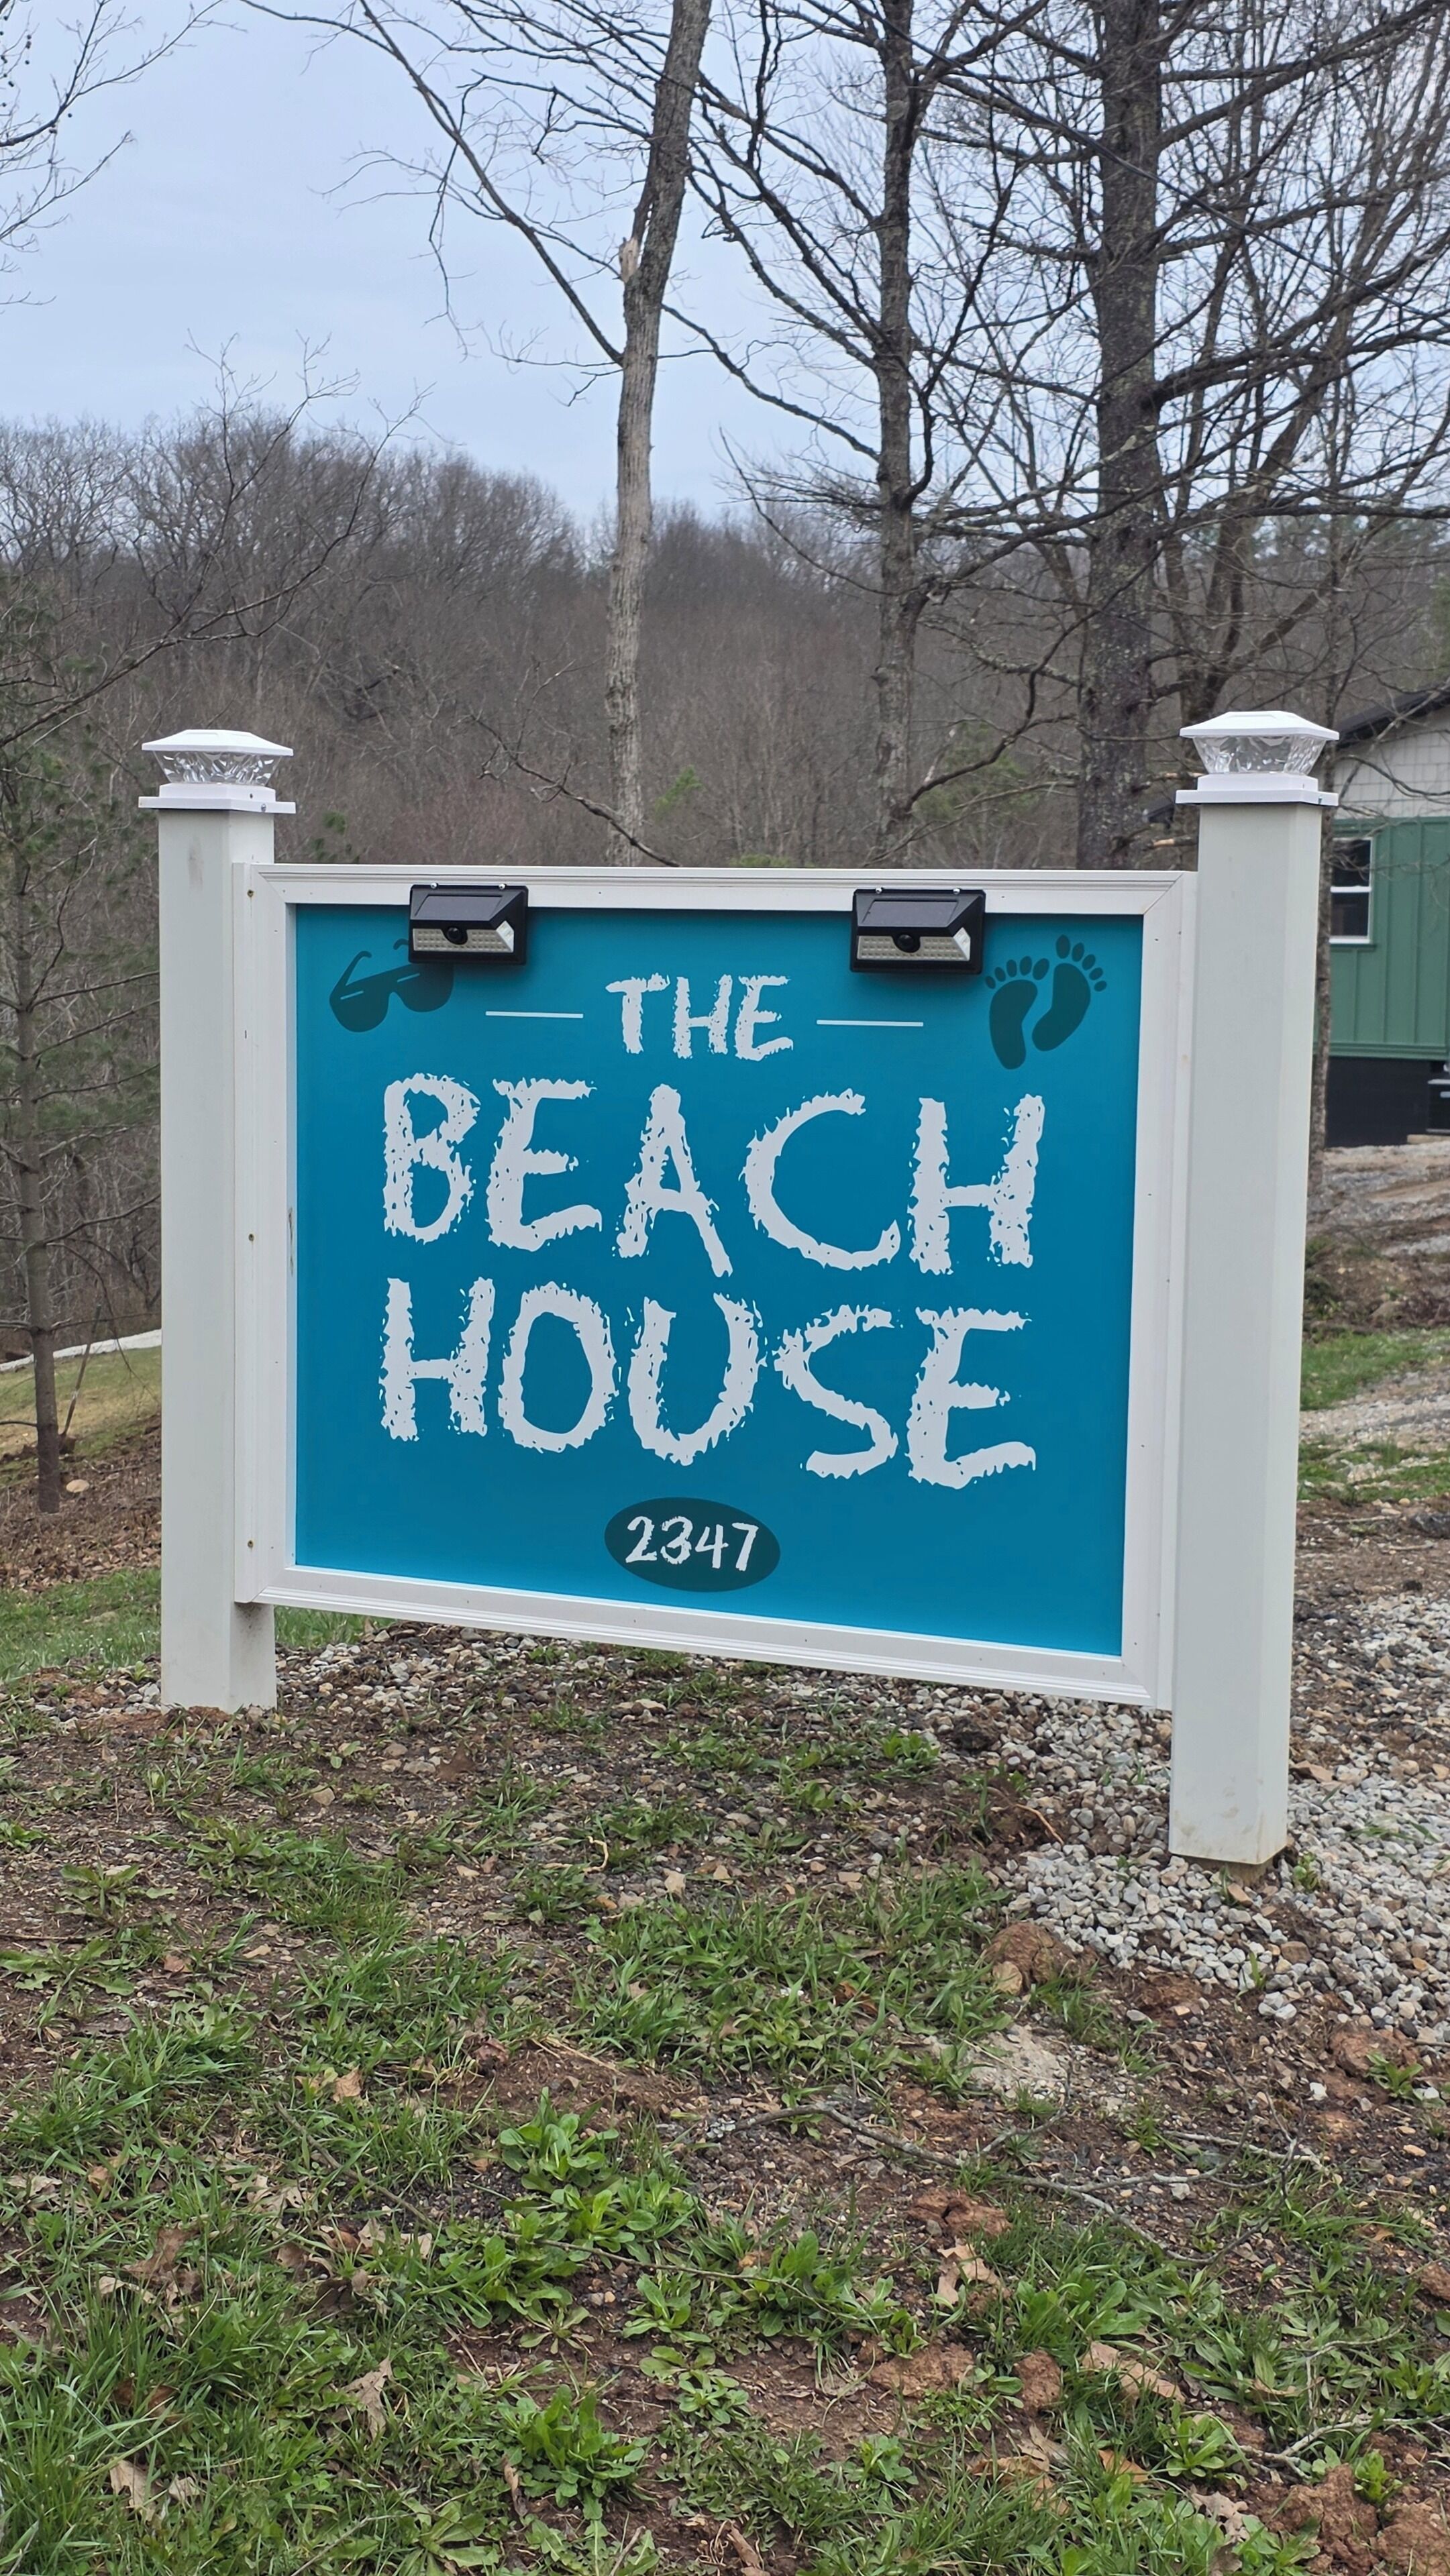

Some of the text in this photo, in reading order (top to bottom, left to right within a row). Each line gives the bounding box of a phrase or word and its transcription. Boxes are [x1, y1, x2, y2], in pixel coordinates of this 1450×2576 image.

[606, 973, 793, 1061] THE
[383, 1073, 1045, 1277] BEACH
[379, 1277, 1035, 1489] HOUSE
[626, 1516, 758, 1571] 2347
